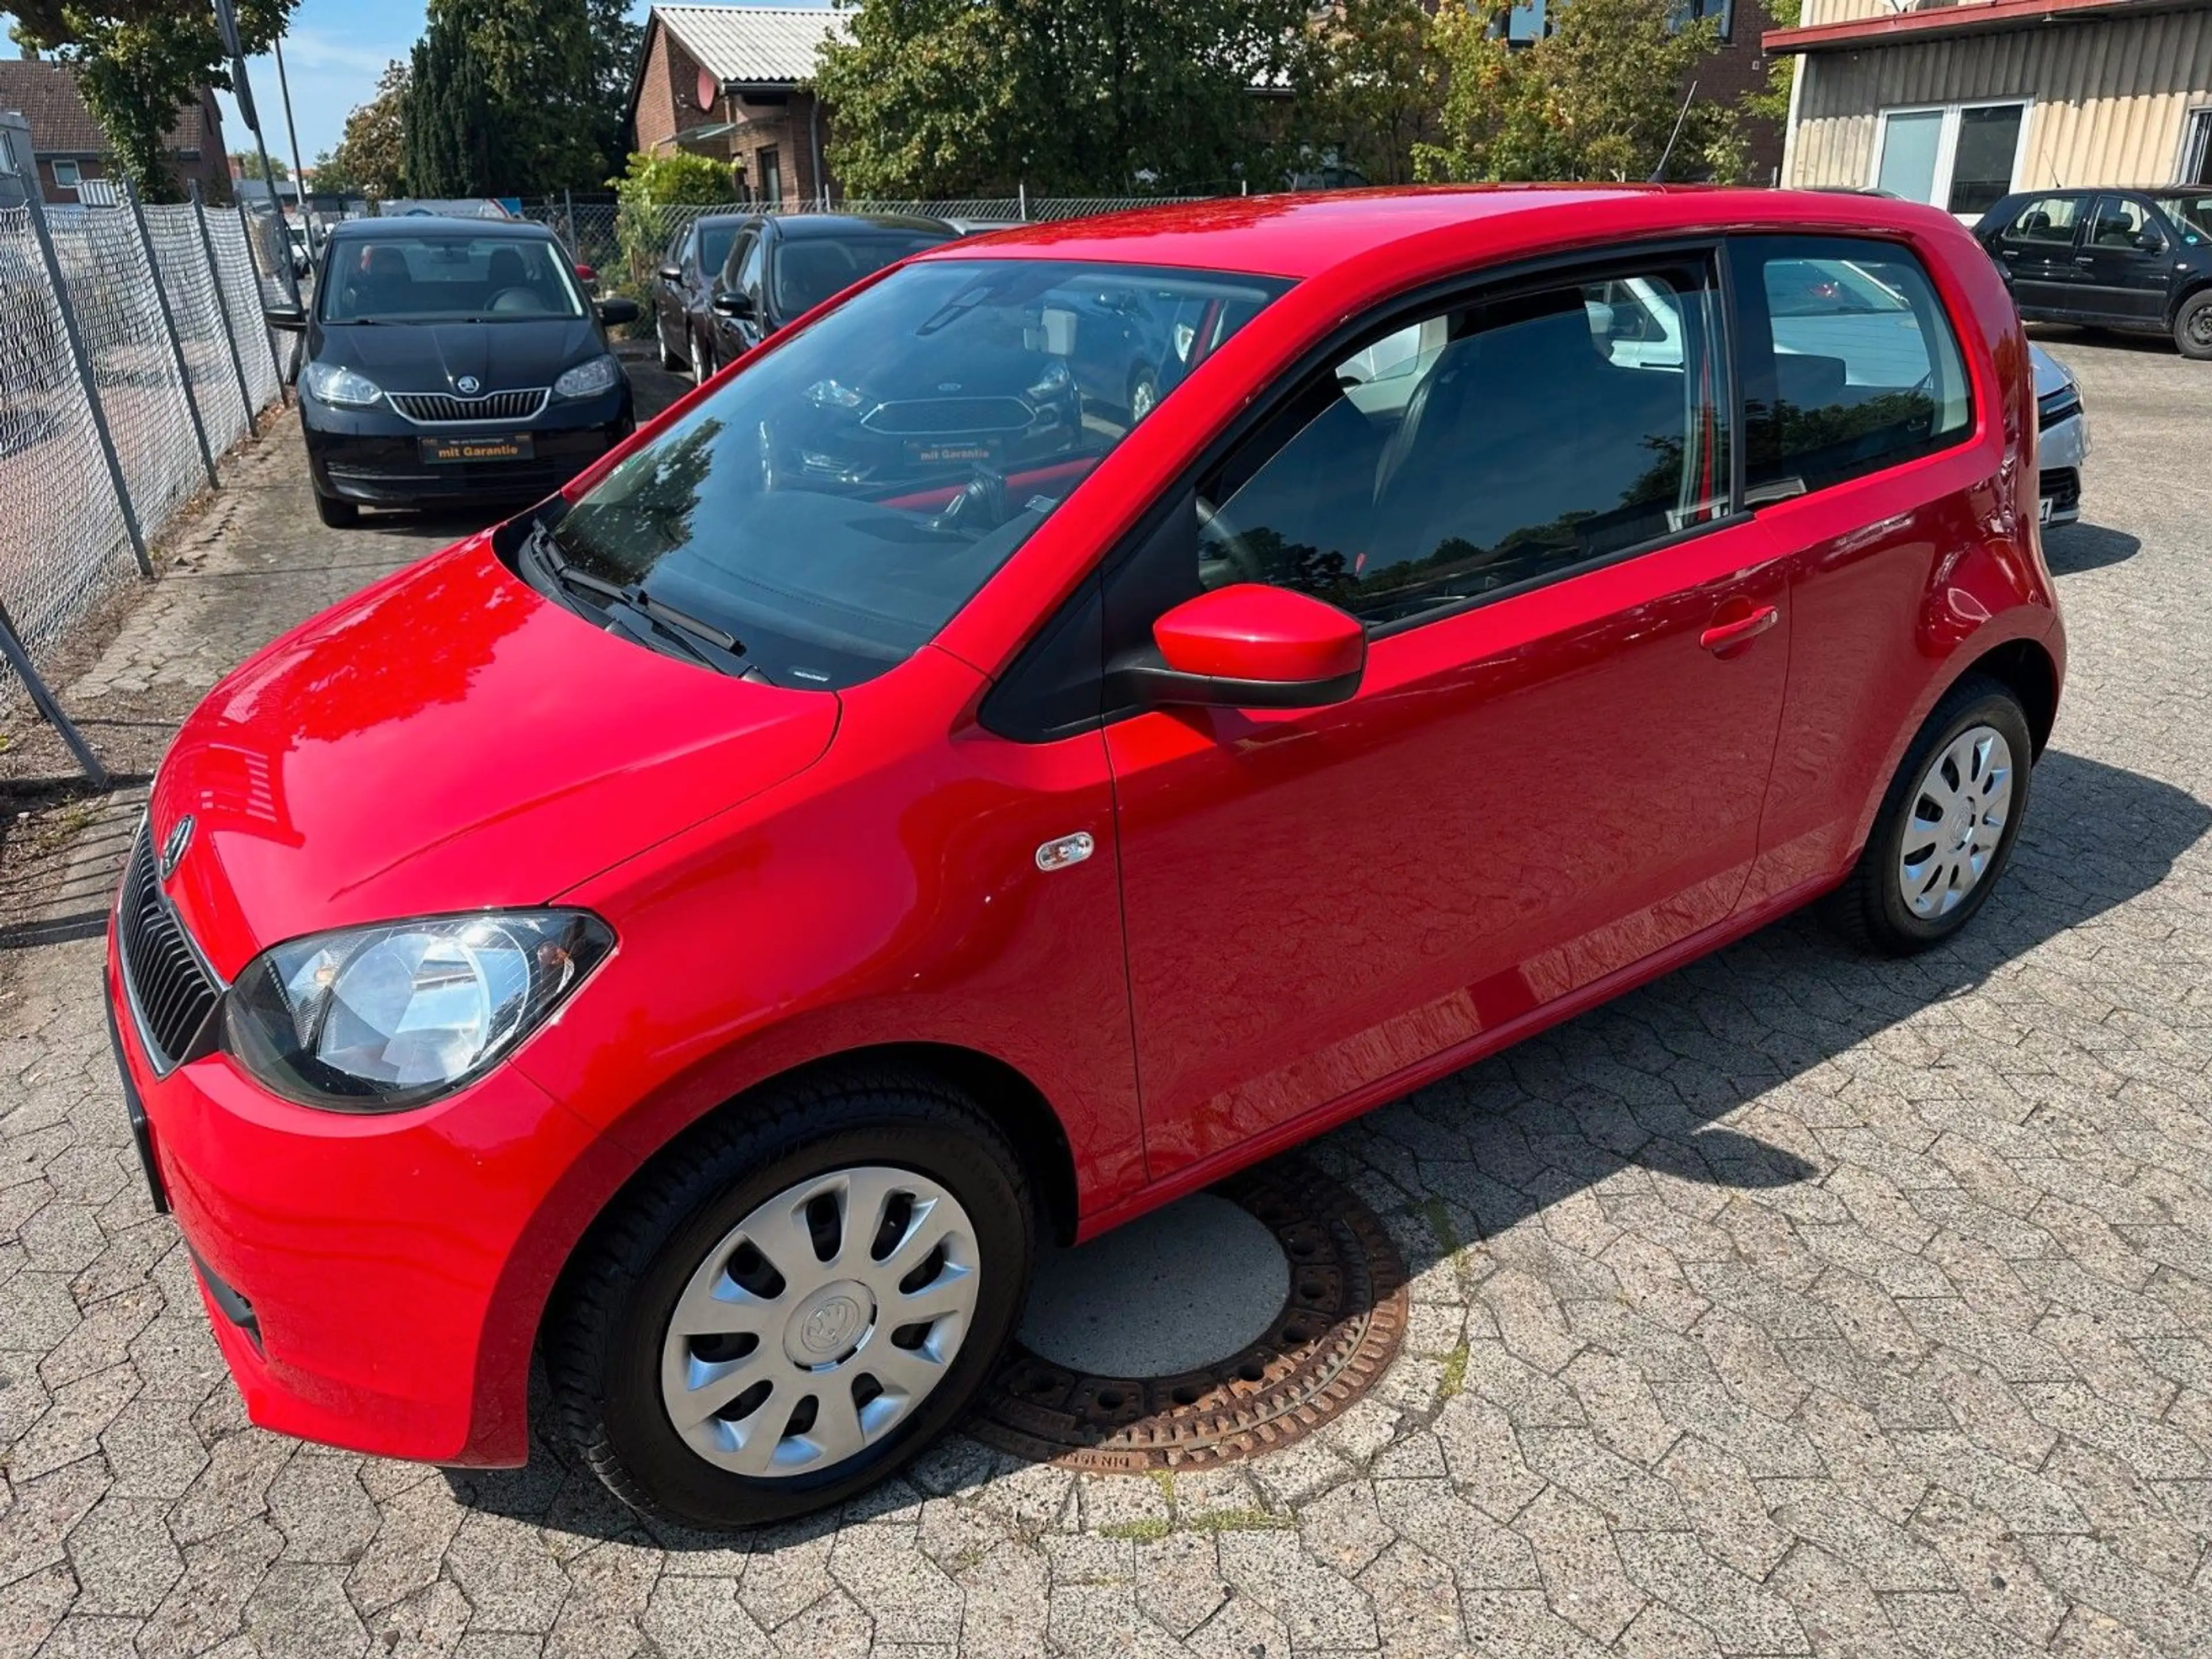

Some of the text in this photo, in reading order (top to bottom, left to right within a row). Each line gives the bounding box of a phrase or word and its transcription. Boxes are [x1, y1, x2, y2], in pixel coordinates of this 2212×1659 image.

[438, 445, 518, 459] mit Garantie
[921, 450, 938, 461] mit
